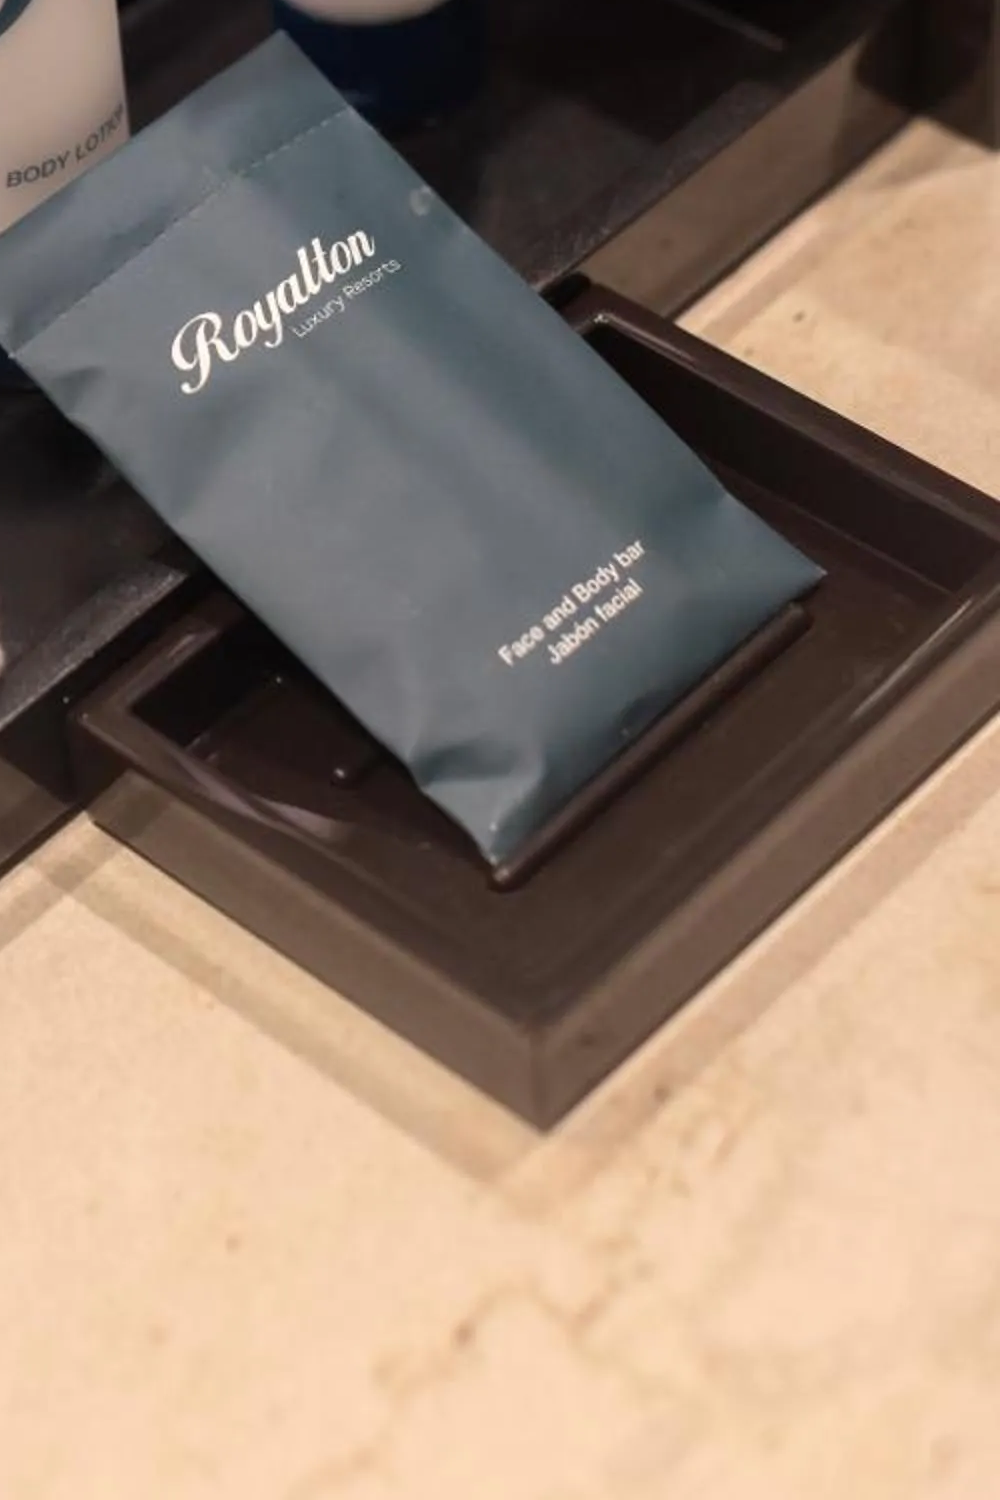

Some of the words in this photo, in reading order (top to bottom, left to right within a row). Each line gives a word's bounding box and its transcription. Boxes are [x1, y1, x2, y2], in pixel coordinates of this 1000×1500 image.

[6, 149, 71, 188] BODY
[171, 230, 375, 394] Royalton
[292, 295, 345, 338] Luxury
[343, 258, 401, 299] Resorts
[498, 626, 545, 666] Face
[543, 595, 577, 631] and
[571, 562, 620, 603] Body
[613, 540, 645, 567] bar
[548, 620, 600, 664] Jabón
[594, 577, 643, 622] facial
